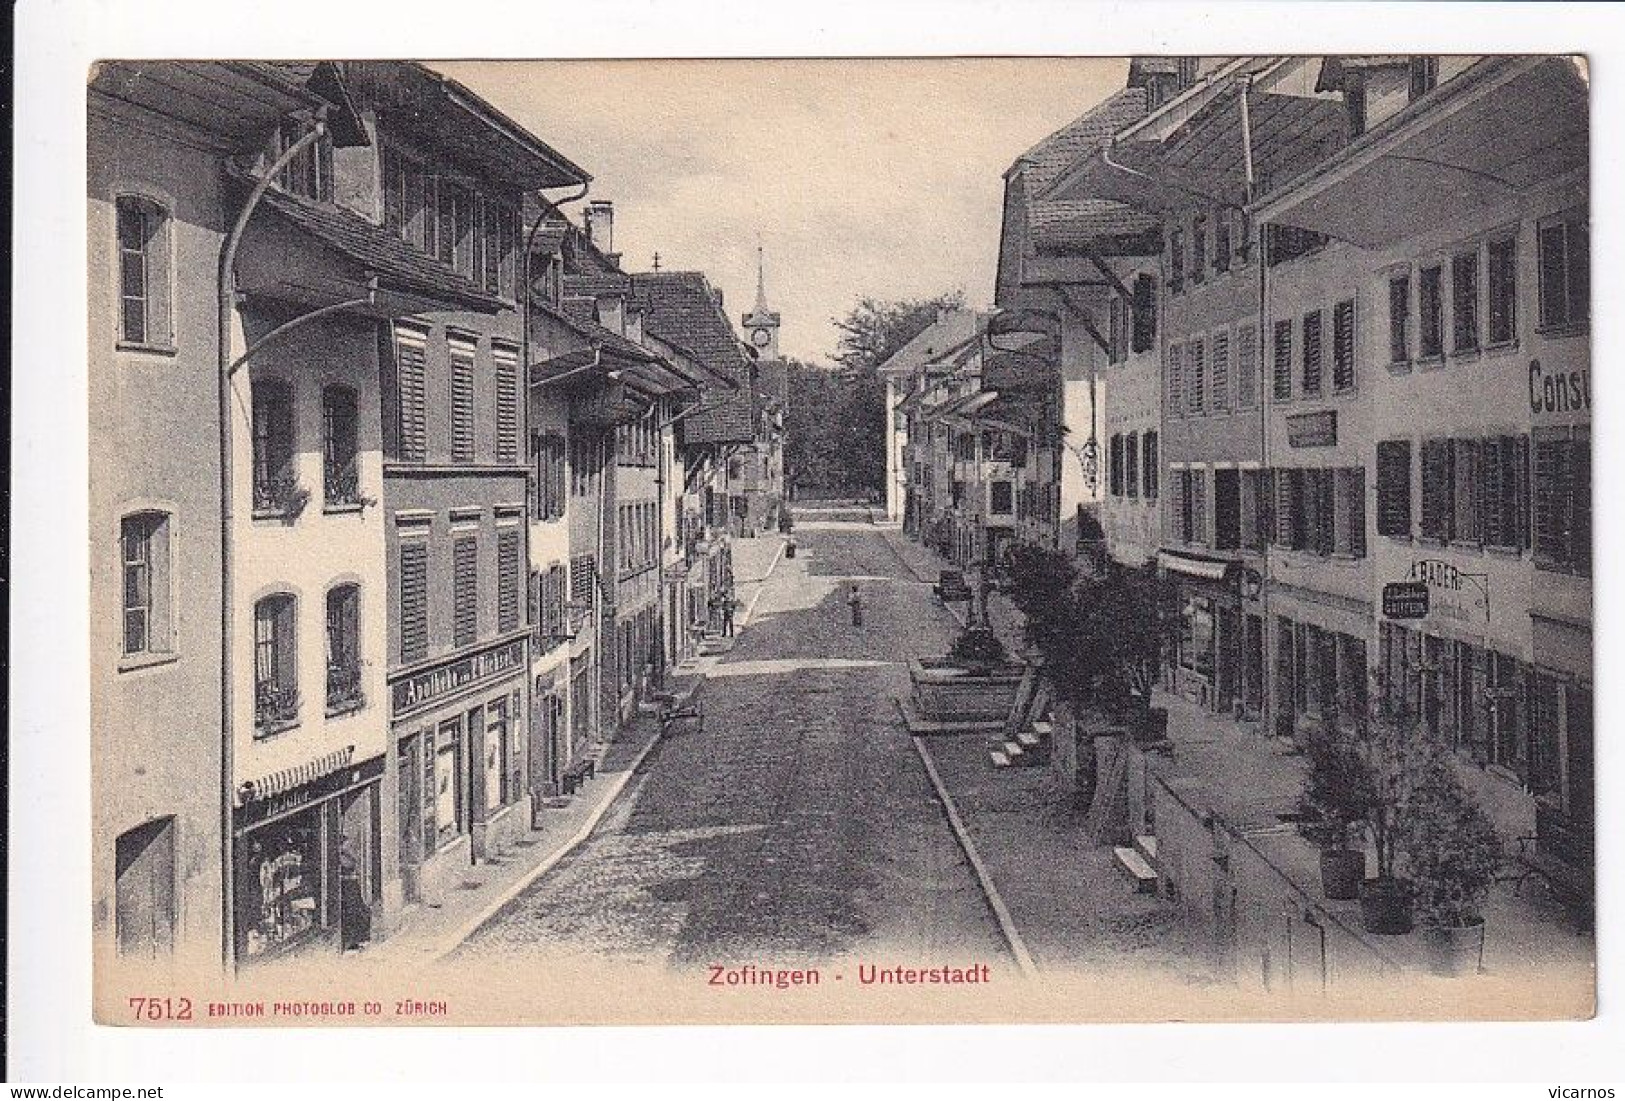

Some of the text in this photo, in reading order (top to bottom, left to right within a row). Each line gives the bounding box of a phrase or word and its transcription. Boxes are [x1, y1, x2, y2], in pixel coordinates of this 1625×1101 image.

[708, 965, 820, 988] Zofingen
[859, 964, 991, 984] Unterstadt
[129, 997, 448, 1020] 7512 EDITION PHOTOGLOB CO ZÜRICH
